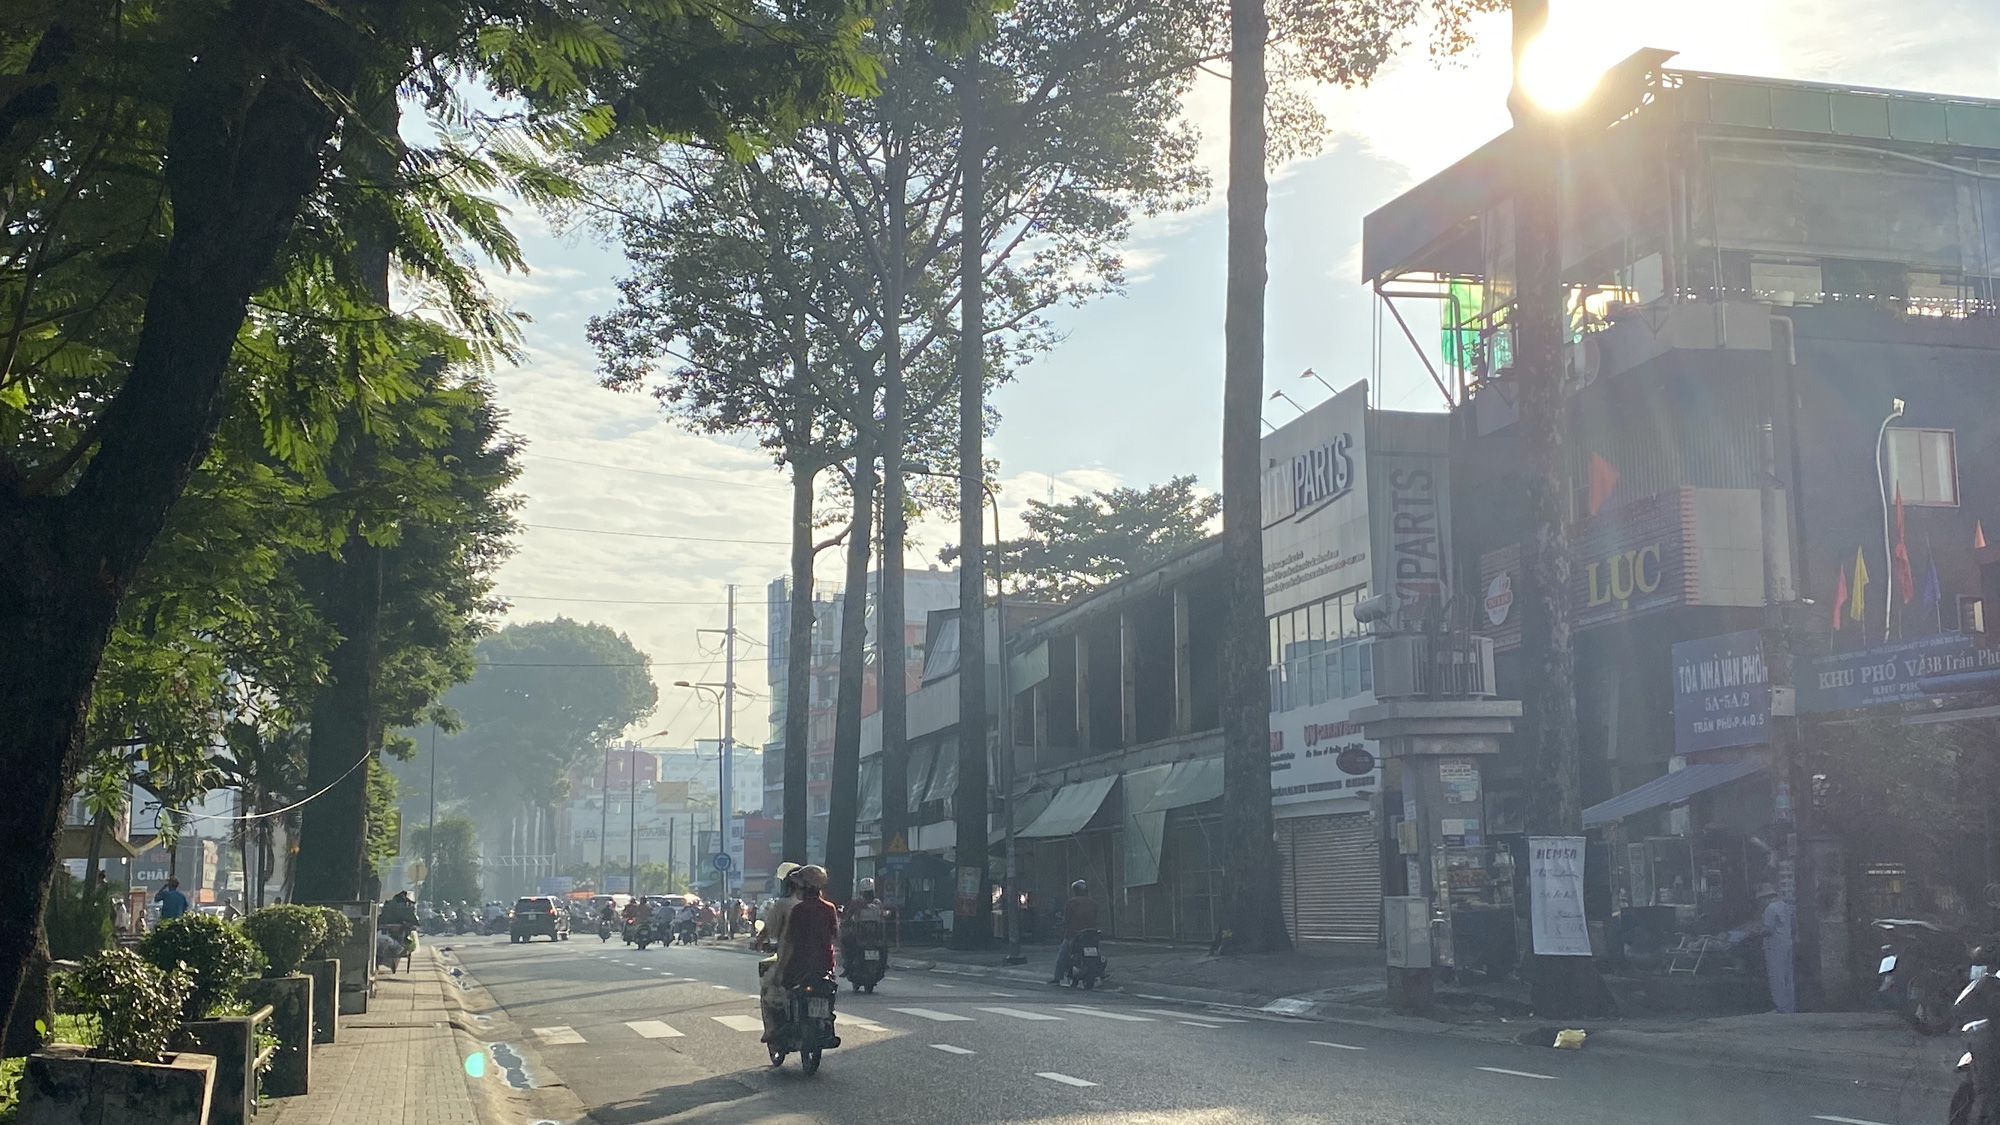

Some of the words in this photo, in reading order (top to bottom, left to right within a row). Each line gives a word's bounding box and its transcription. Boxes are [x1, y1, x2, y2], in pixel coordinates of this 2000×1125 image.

[1390, 468, 1437, 579] PARTS
[1585, 543, 1661, 610] LỤC
[1679, 658, 1698, 694] TÒA
[1700, 653, 1721, 690] NHÀ
[1742, 645, 1768, 684] PHÒN
[1818, 668, 1854, 689] KHU
[1860, 654, 1897, 684] PHỐ
